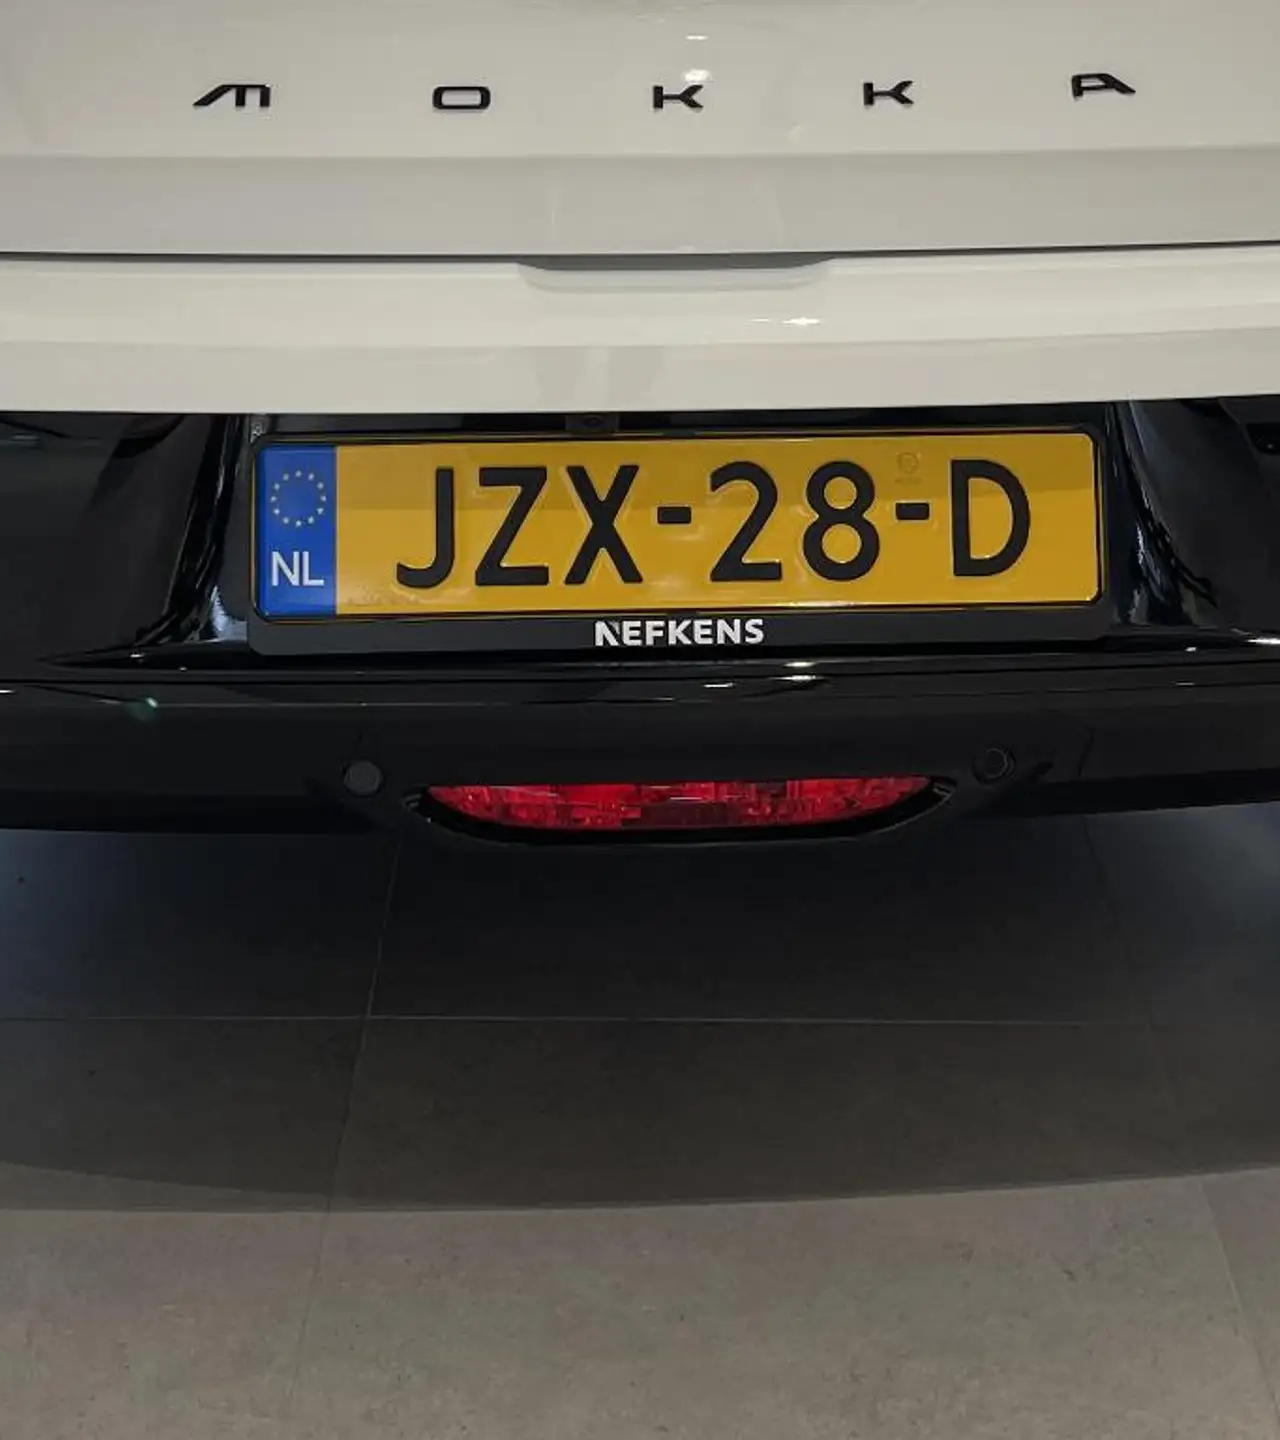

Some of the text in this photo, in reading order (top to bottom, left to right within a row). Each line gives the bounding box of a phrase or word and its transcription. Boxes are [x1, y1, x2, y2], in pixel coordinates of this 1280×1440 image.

[194, 72, 1136, 112] MOKKA
[396, 459, 1031, 589] JZX-28-D
[271, 550, 324, 587] NL
[594, 618, 764, 647] NEFKENS
